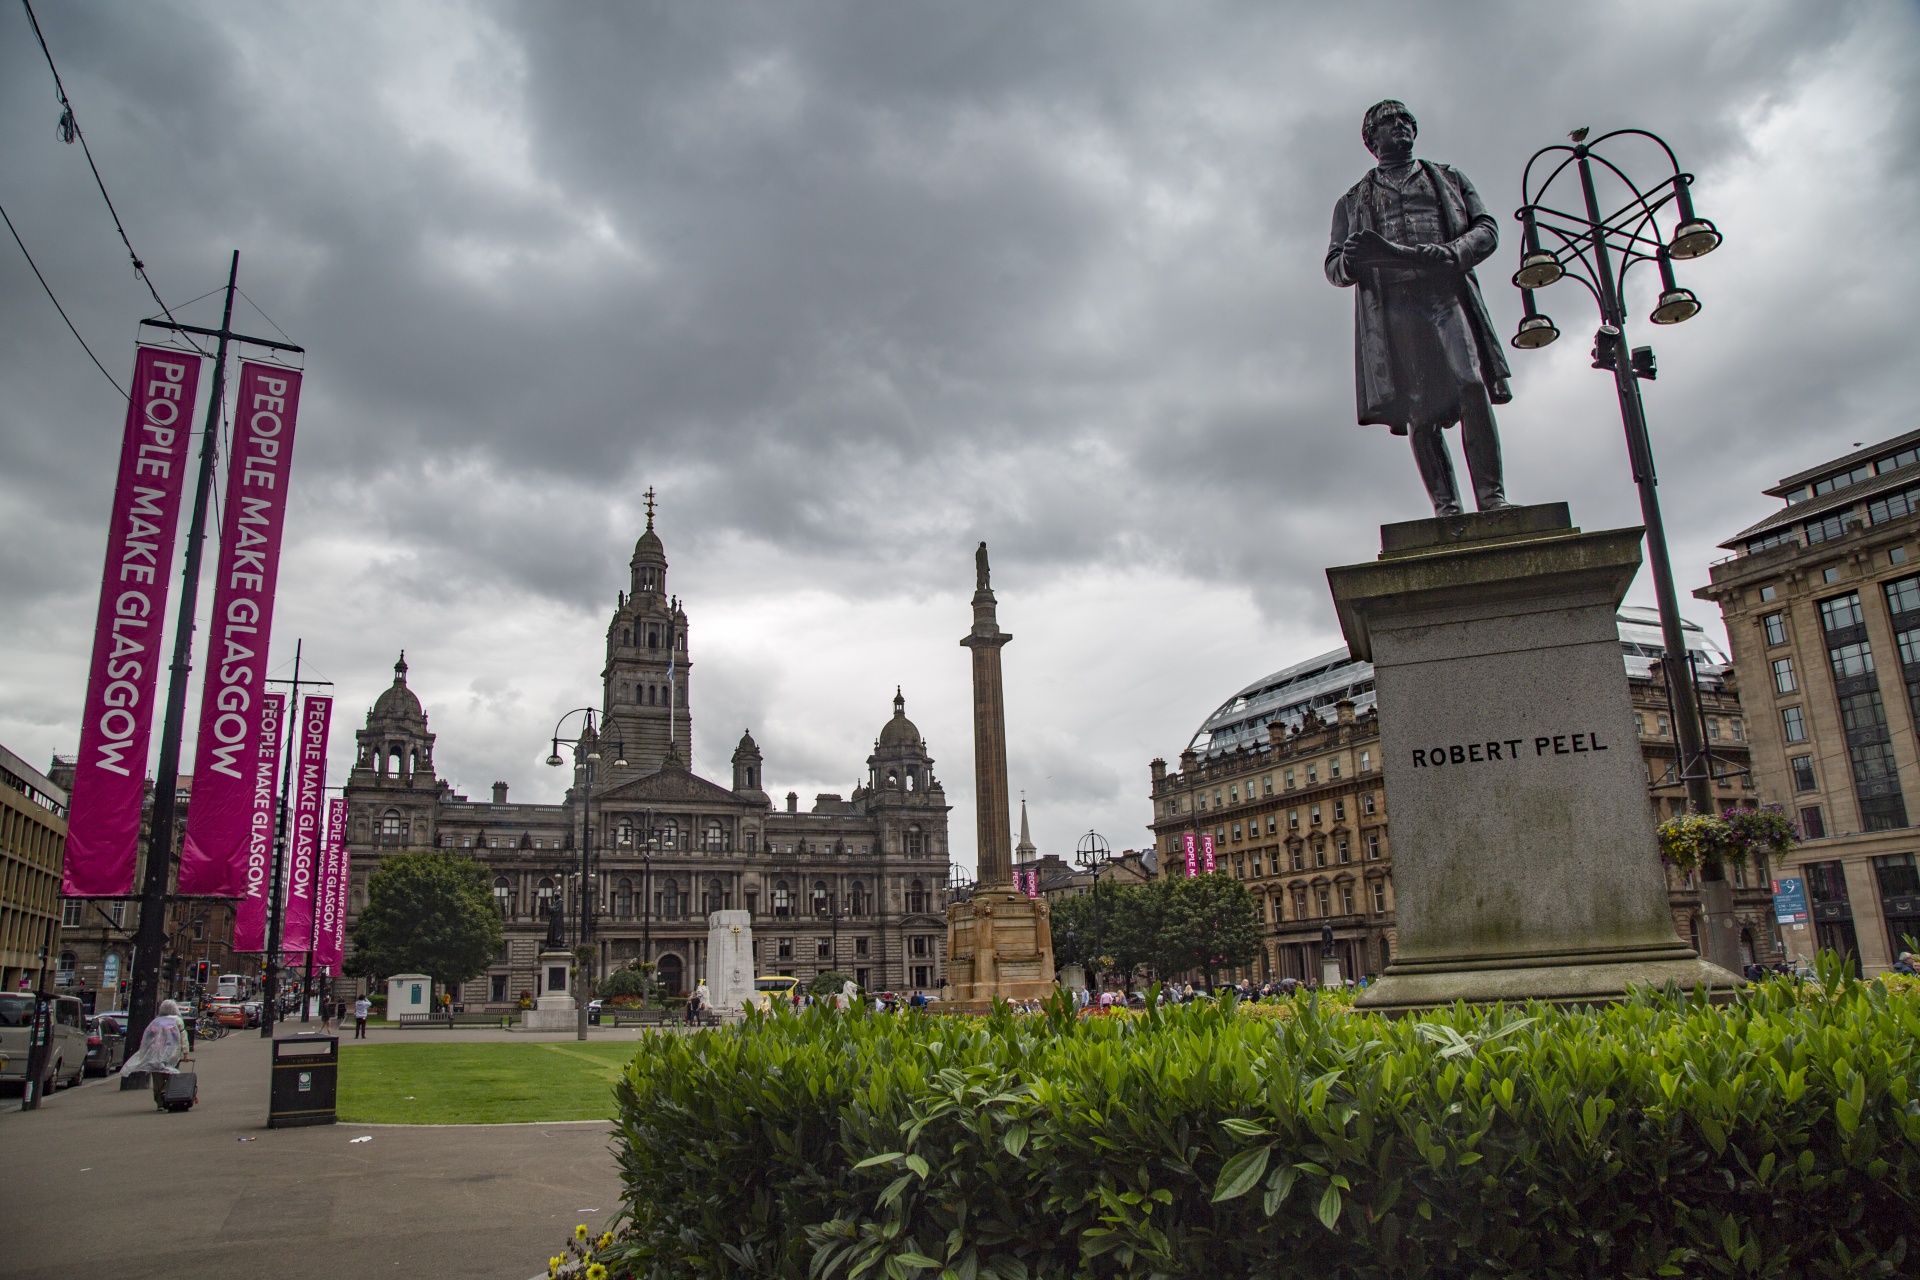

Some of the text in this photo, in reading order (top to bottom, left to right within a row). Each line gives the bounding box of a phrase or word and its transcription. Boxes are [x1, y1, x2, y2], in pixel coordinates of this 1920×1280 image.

[95, 360, 185, 777] PEOPLE MAKE GLASGOW
[210, 375, 287, 779] PEOPLE MAKE GLASGOW
[247, 699, 278, 898] PEOPLE MAKE GLASGOW
[293, 701, 326, 899] PEOPLE MAKE GLASGOW
[1412, 732, 1608, 768] ROBERT PEEL
[323, 801, 343, 933] PEOPLE MAKE GLASGOW
[1186, 836, 1196, 867] PEOPLE
[1204, 837, 1214, 867] PEOPLE
